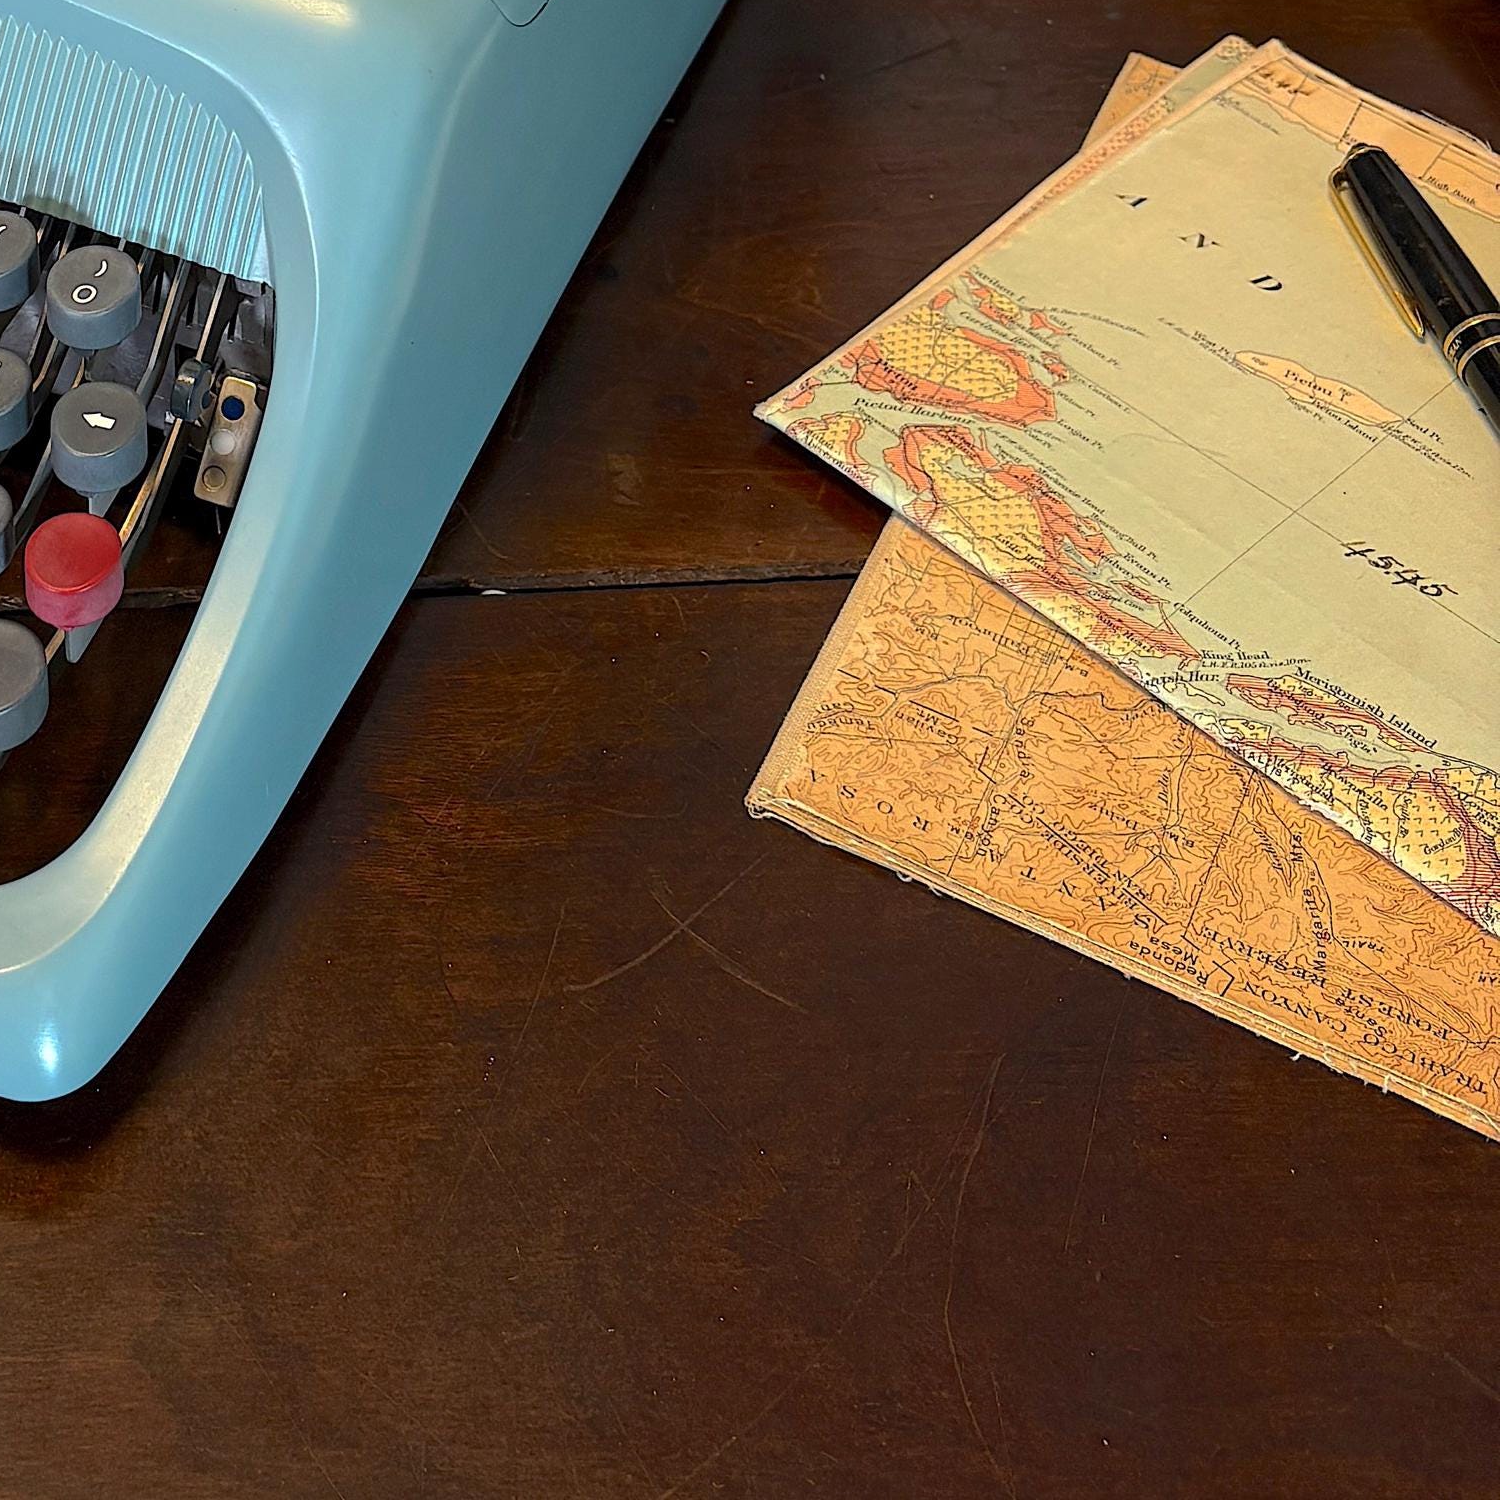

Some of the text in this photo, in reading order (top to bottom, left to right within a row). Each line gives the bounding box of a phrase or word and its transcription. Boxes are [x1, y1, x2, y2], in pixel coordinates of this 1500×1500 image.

[894, 710, 960, 747] Gavilan
[1294, 666, 1439, 750] Merigomish Island
[1051, 819, 1112, 870] DIEGO
[1040, 830, 1138, 911] RIVERSIDE
[1112, 867, 1152, 901] SAN
[1128, 940, 1210, 987] Redonda
[1148, 934, 1199, 966] Mesa
[1200, 924, 1453, 1041] FOREST RESERVE
[1241, 980, 1488, 1095] TRABUCO CANYON
